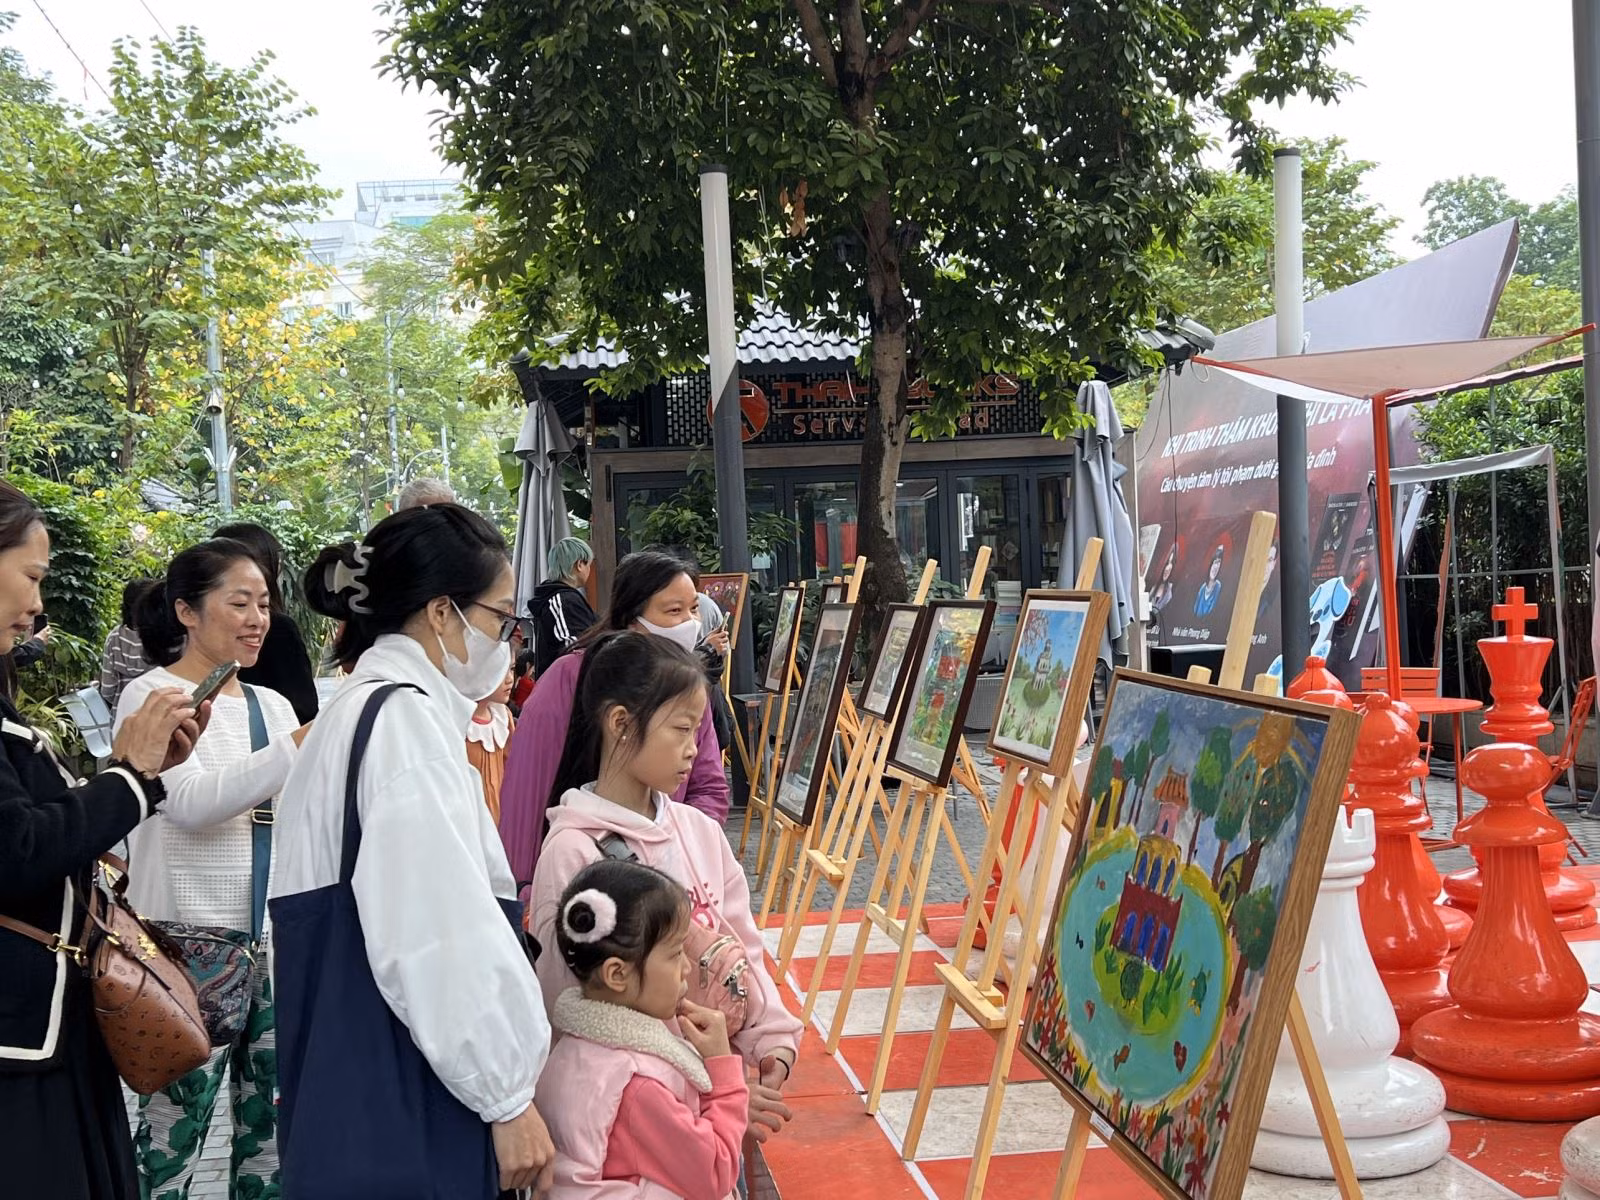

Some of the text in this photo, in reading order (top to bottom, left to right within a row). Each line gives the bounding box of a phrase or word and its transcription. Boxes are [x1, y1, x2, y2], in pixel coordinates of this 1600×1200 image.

[793, 414, 867, 435] Serv
[1161, 432, 1185, 458] KHI
[1180, 426, 1218, 455] TRINH
